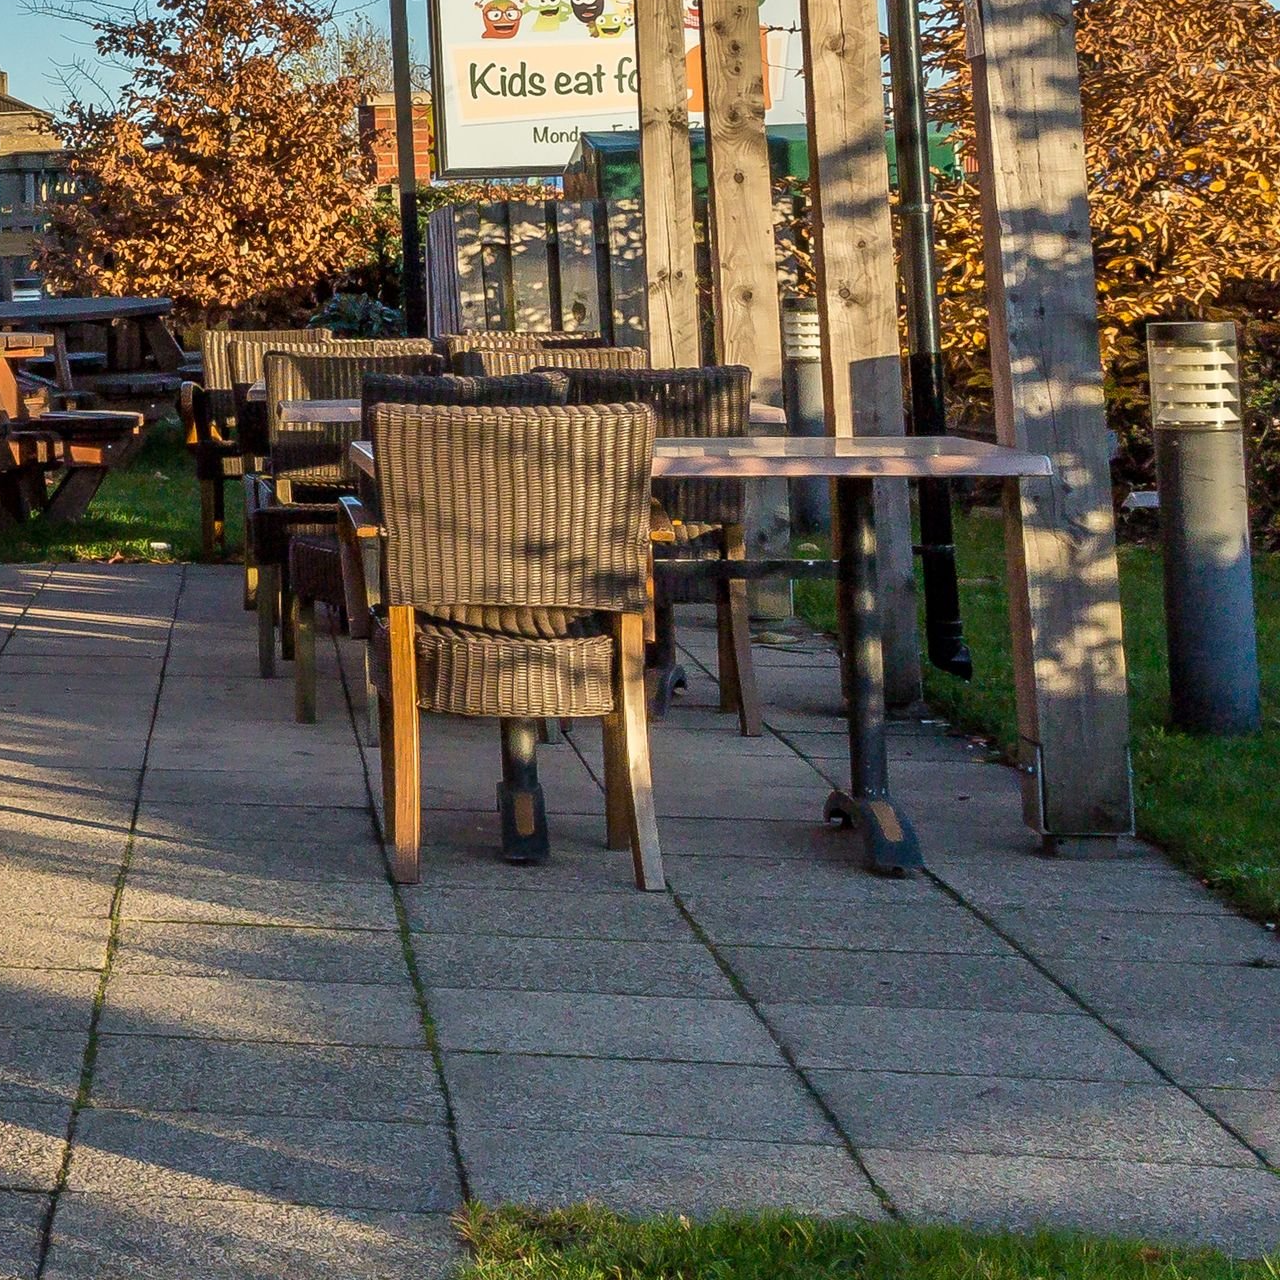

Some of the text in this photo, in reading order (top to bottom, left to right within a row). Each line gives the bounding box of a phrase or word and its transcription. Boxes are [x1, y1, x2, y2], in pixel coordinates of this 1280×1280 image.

[469, 56, 639, 99] Kids eat fo
[533, 126, 580, 144] Mond
